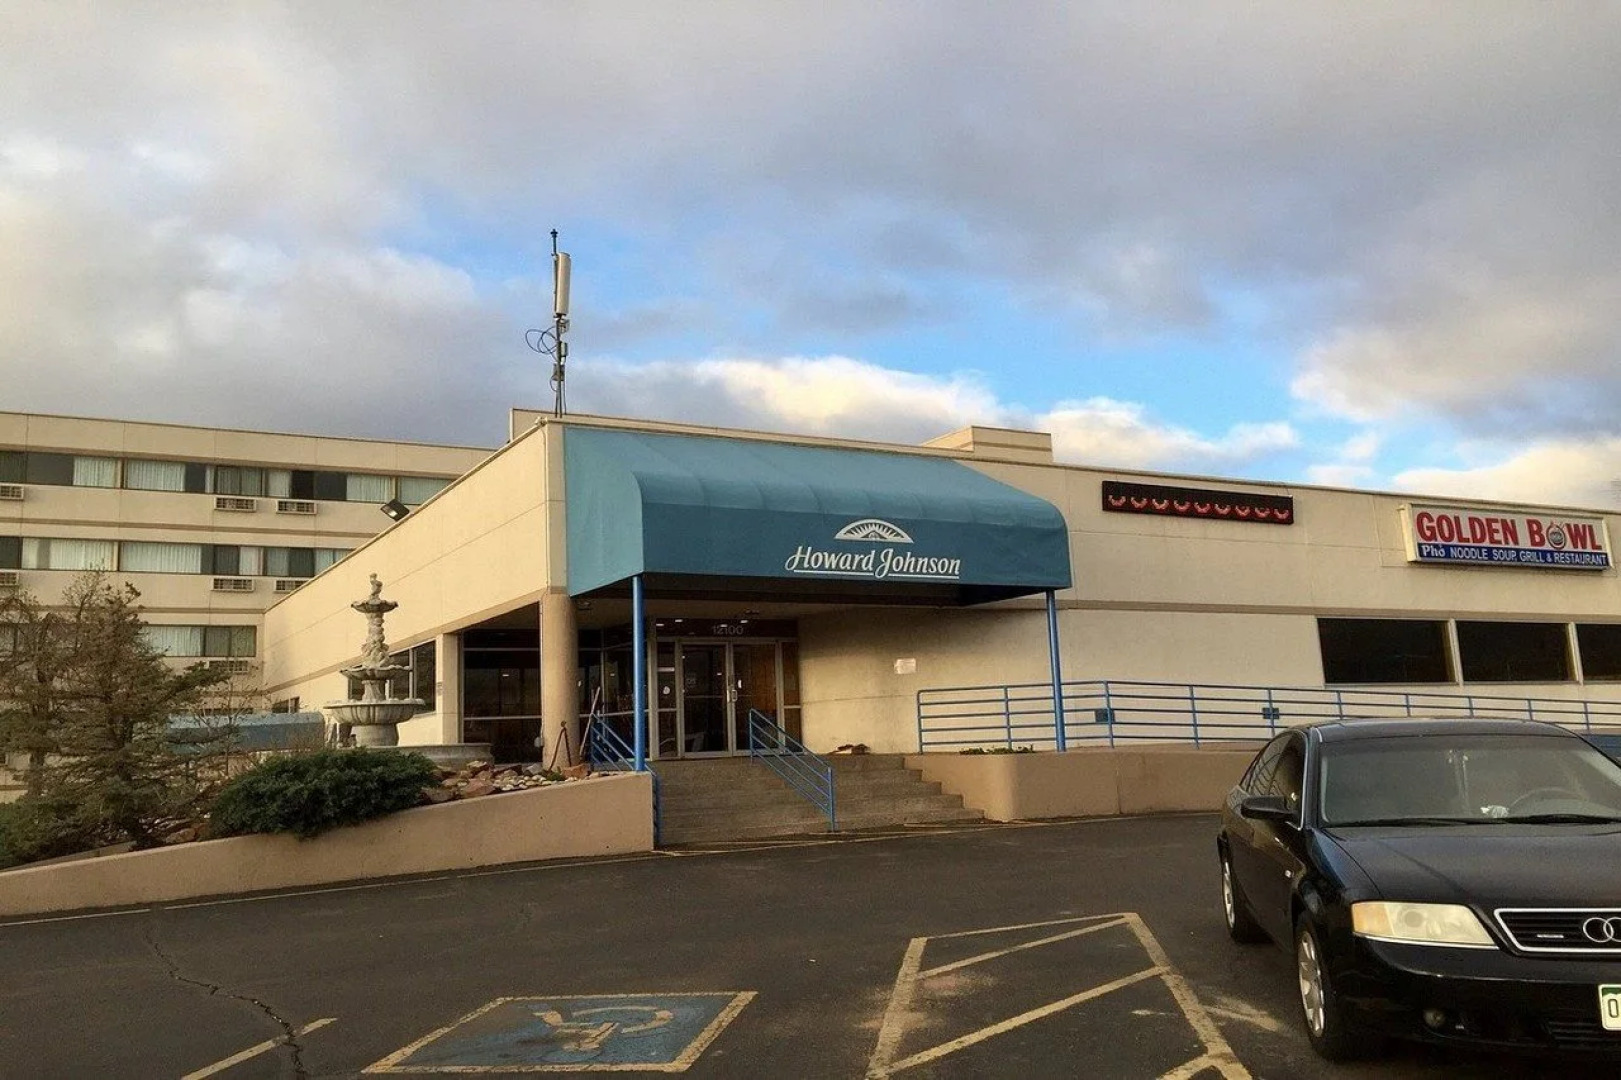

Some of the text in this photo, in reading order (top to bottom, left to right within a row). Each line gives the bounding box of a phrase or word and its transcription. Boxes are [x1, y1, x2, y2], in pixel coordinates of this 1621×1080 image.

[1416, 511, 1603, 551] GOLDEN BOWL
[784, 545, 961, 579] Howard Johnson
[1449, 547, 1489, 561] NOODLE
[1519, 550, 1546, 563] GRILL
[1553, 552, 1607, 566] RESTAURANT
